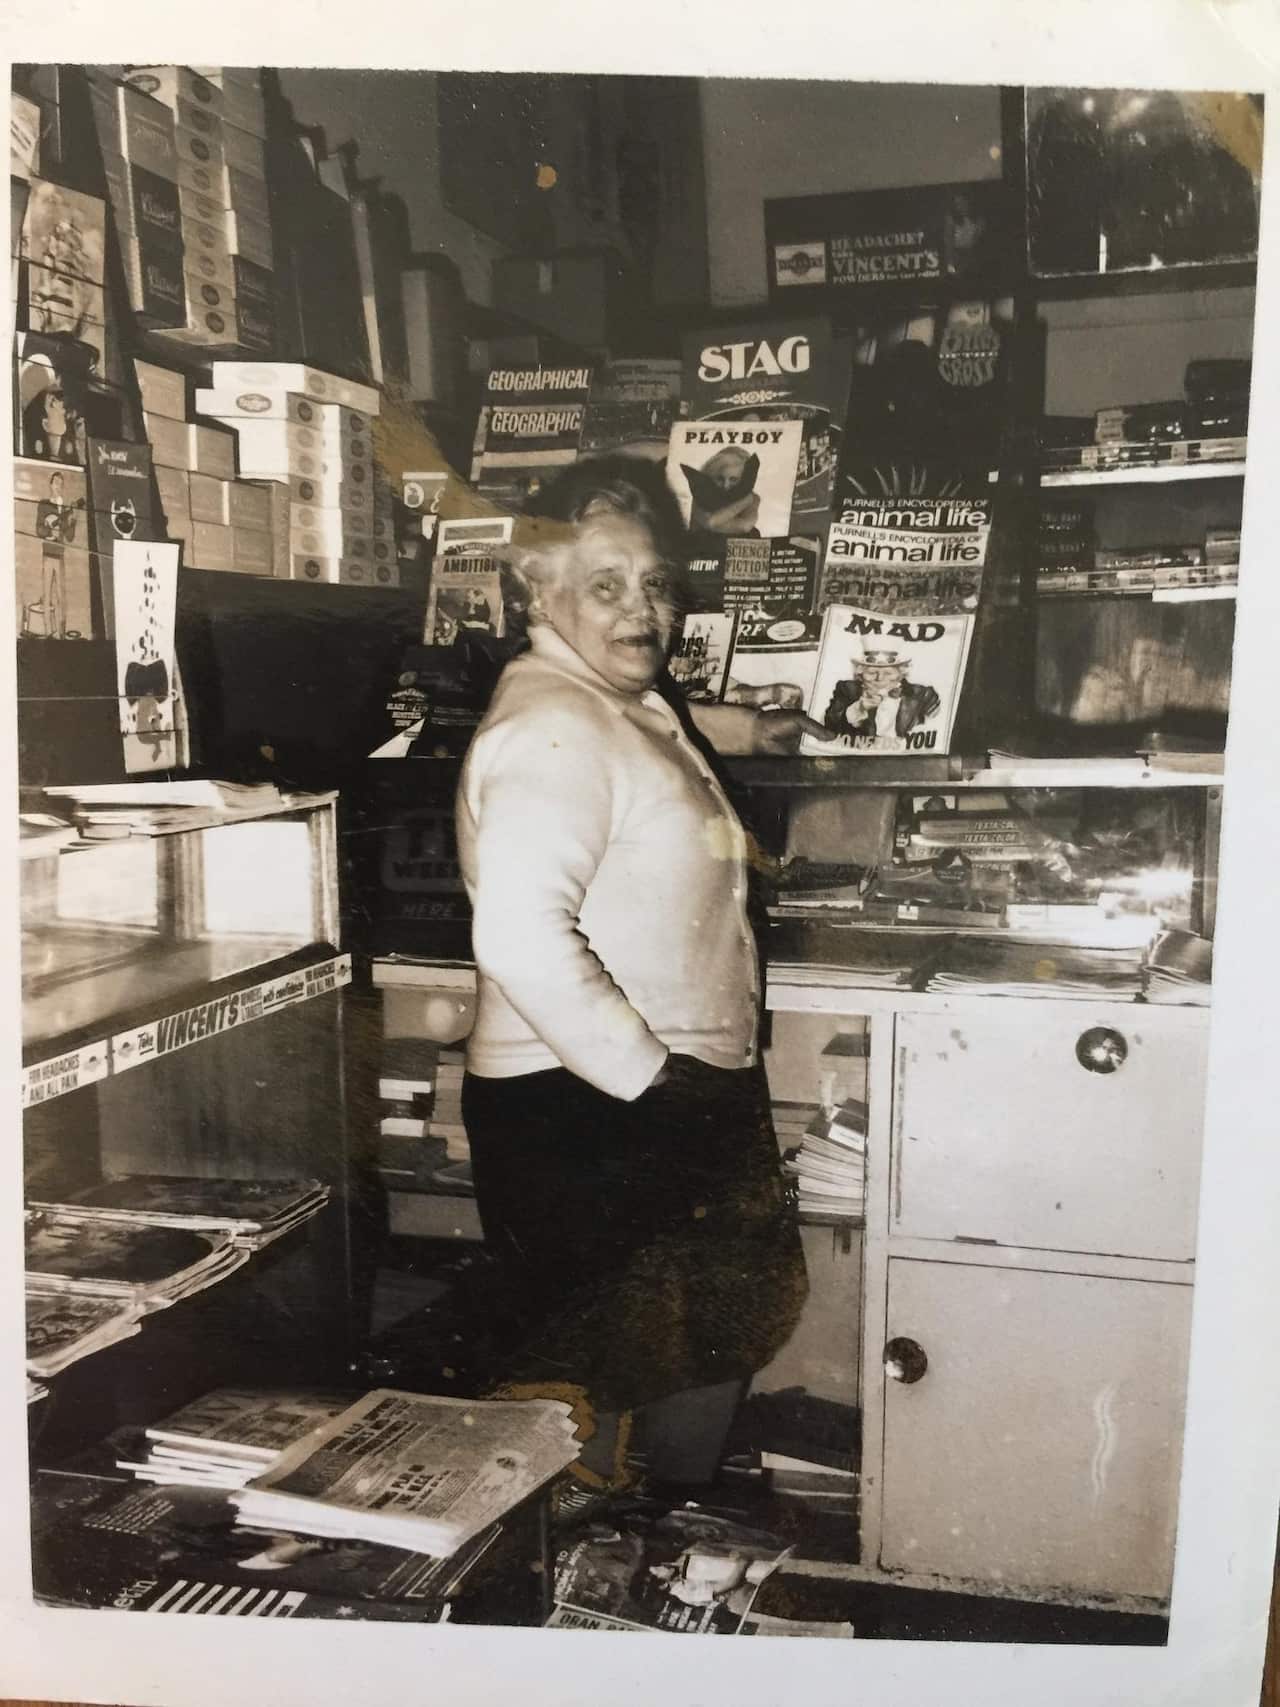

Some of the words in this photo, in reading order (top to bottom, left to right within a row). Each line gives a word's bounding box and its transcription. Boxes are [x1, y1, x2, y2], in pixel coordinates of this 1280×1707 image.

[832, 249, 940, 274] VINCENT'S
[698, 336, 810, 382] STAG
[488, 369, 590, 391] GEOGRAPHICAL
[938, 358, 995, 387] CROSS
[490, 412, 581, 433] GEOGRAPHIC
[685, 431, 784, 445] PLAYBOY
[897, 499, 973, 508] ENCYCLOPEDIA
[975, 499, 989, 508] OF
[840, 506, 943, 527] animal
[946, 506, 987, 527] life
[727, 542, 770, 559] SCIENCE
[831, 538, 934, 562] animal
[939, 542, 981, 562] life
[889, 534, 966, 545] ENCYCLOPEDIA
[967, 534, 983, 544] OF
[726, 559, 769, 574] FICTION
[824, 575, 929, 598] animal
[935, 575, 977, 598] life
[844, 613, 946, 643] MAD
[905, 730, 938, 750] YOU
[156, 992, 241, 1054] VINCENT'S
[28, 1066, 42, 1084] FOR
[42, 1053, 80, 1081] HEADACHES
[29, 1084, 46, 1102] AND
[46, 1079, 60, 1097] ALL
[60, 1072, 79, 1092] PAIN
